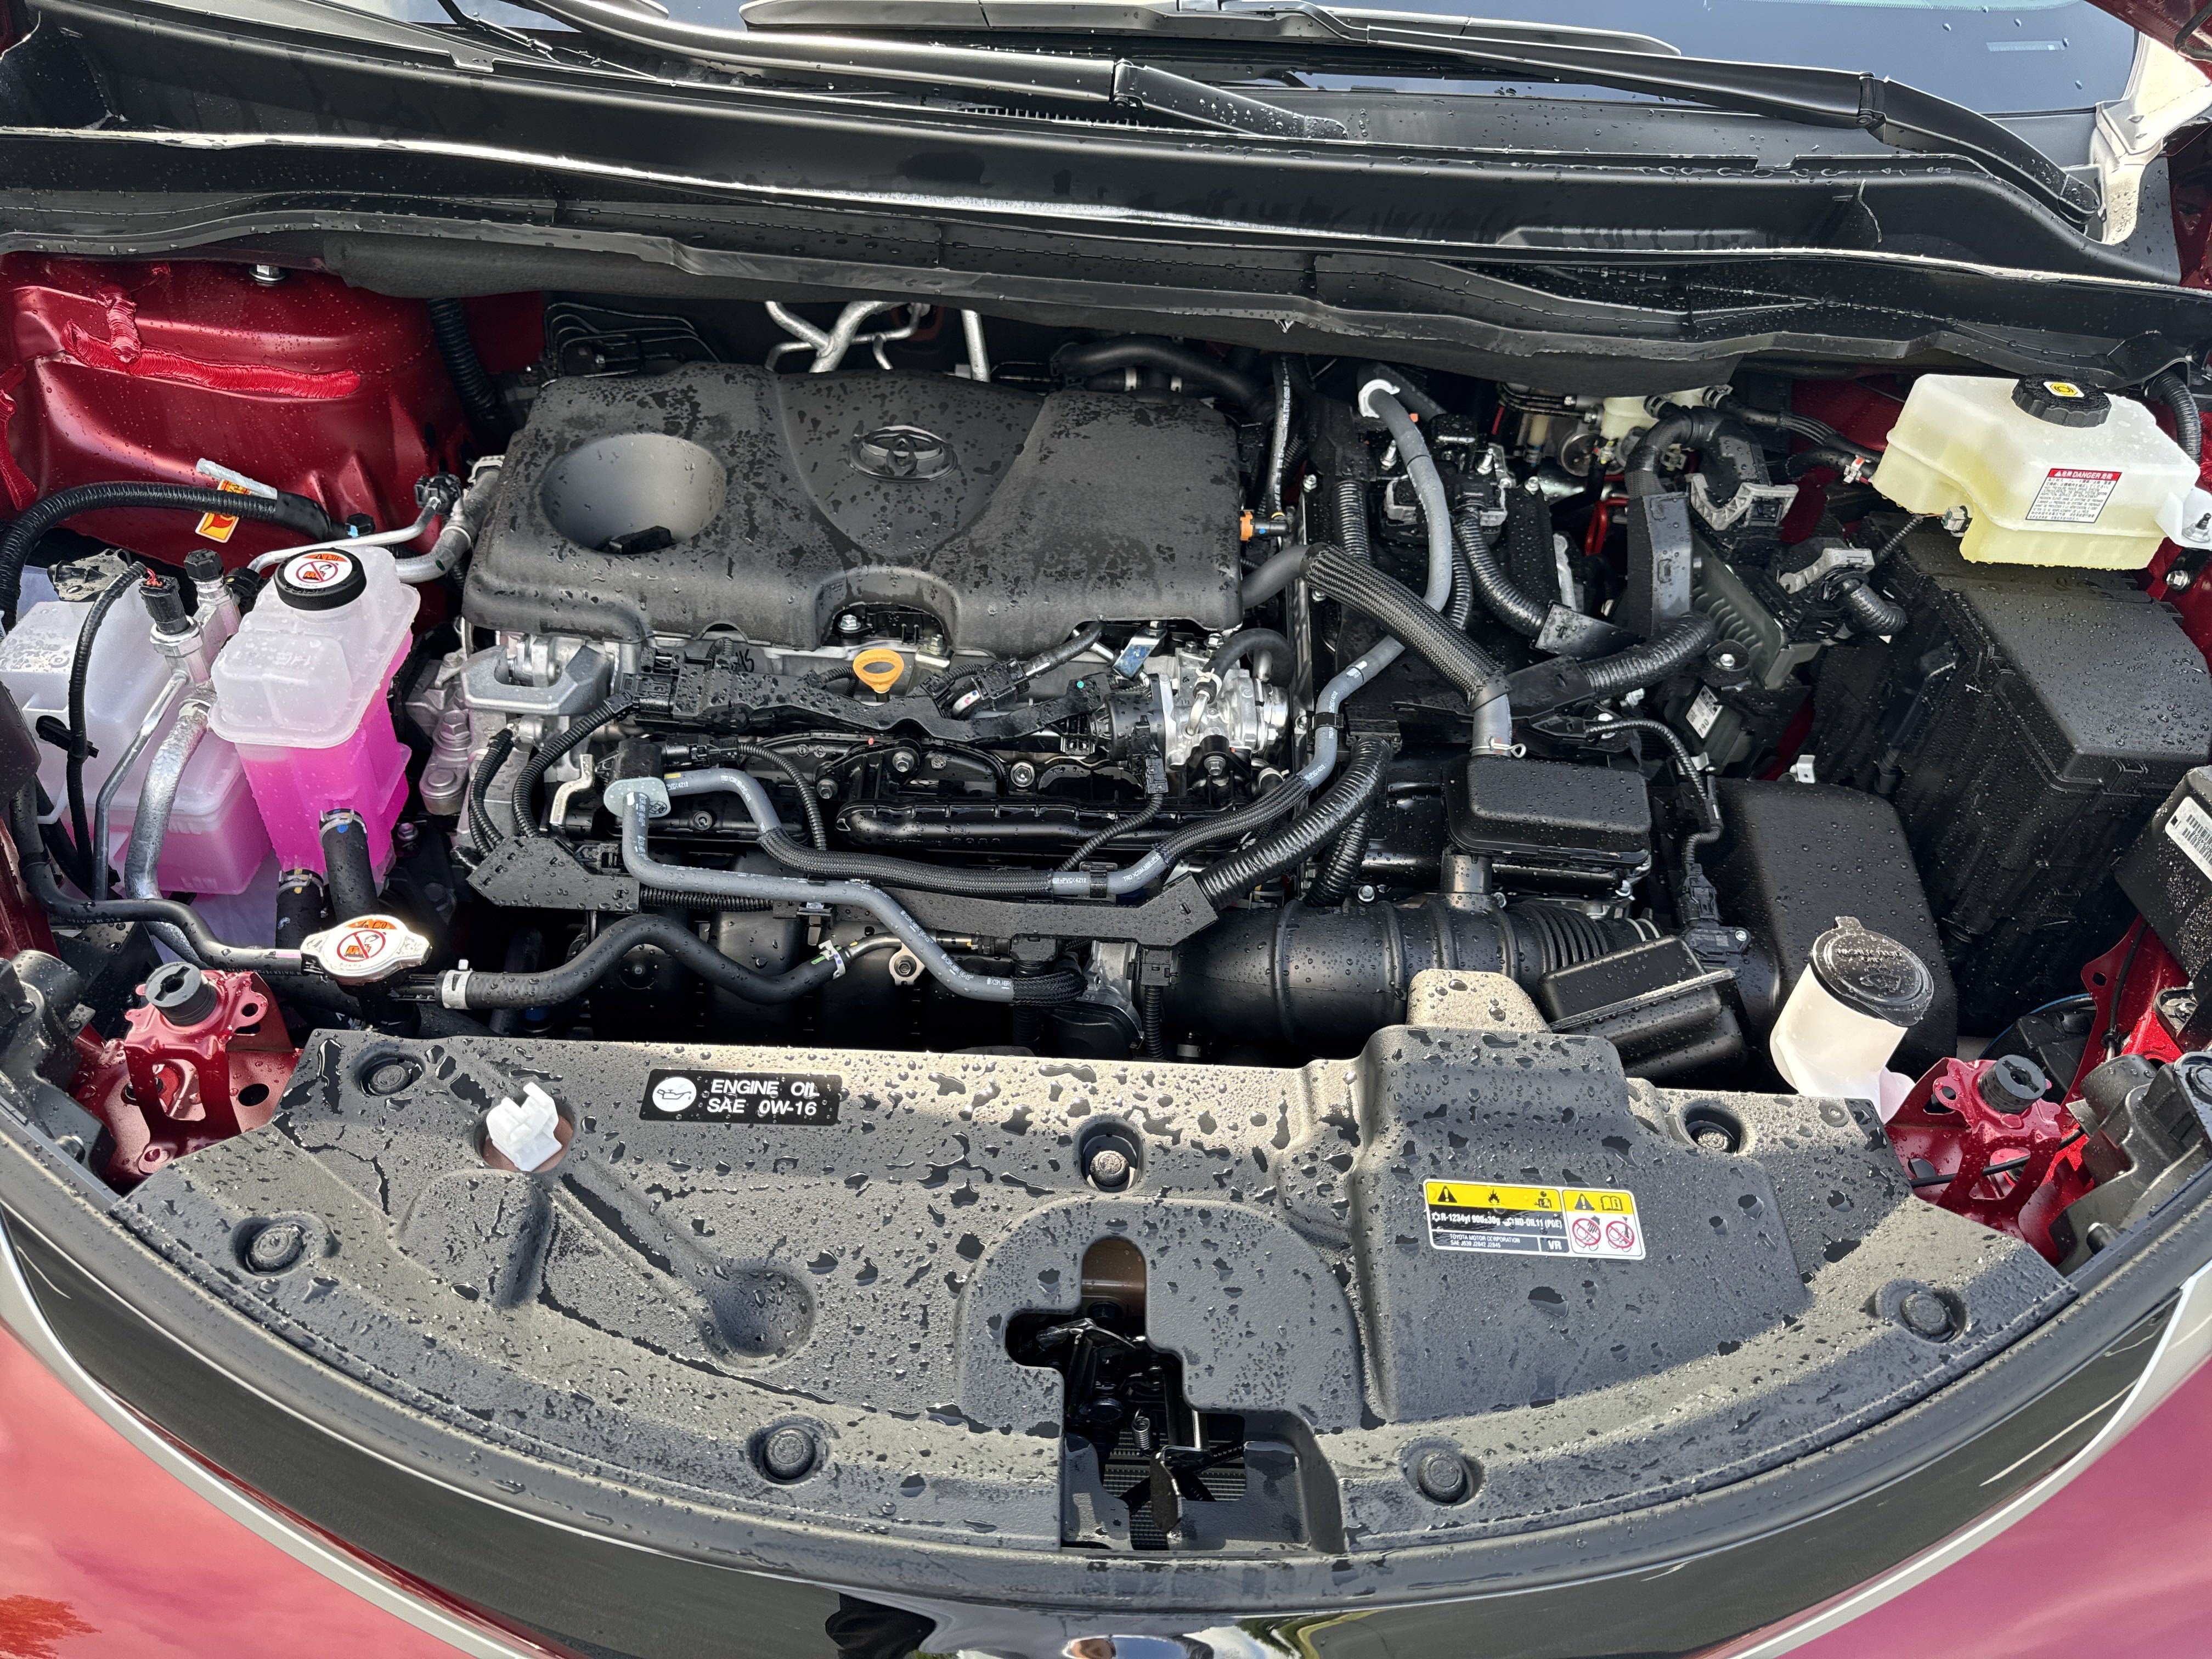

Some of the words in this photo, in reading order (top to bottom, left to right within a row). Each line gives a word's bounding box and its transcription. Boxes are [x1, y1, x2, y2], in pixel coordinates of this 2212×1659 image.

[710, 1079, 780, 1095] ENGINE
[791, 1081, 821, 1097] OIL
[707, 1098, 747, 1114] SAE
[758, 1101, 817, 1116] 0W-16
[1548, 1240, 1562, 1250] VR
